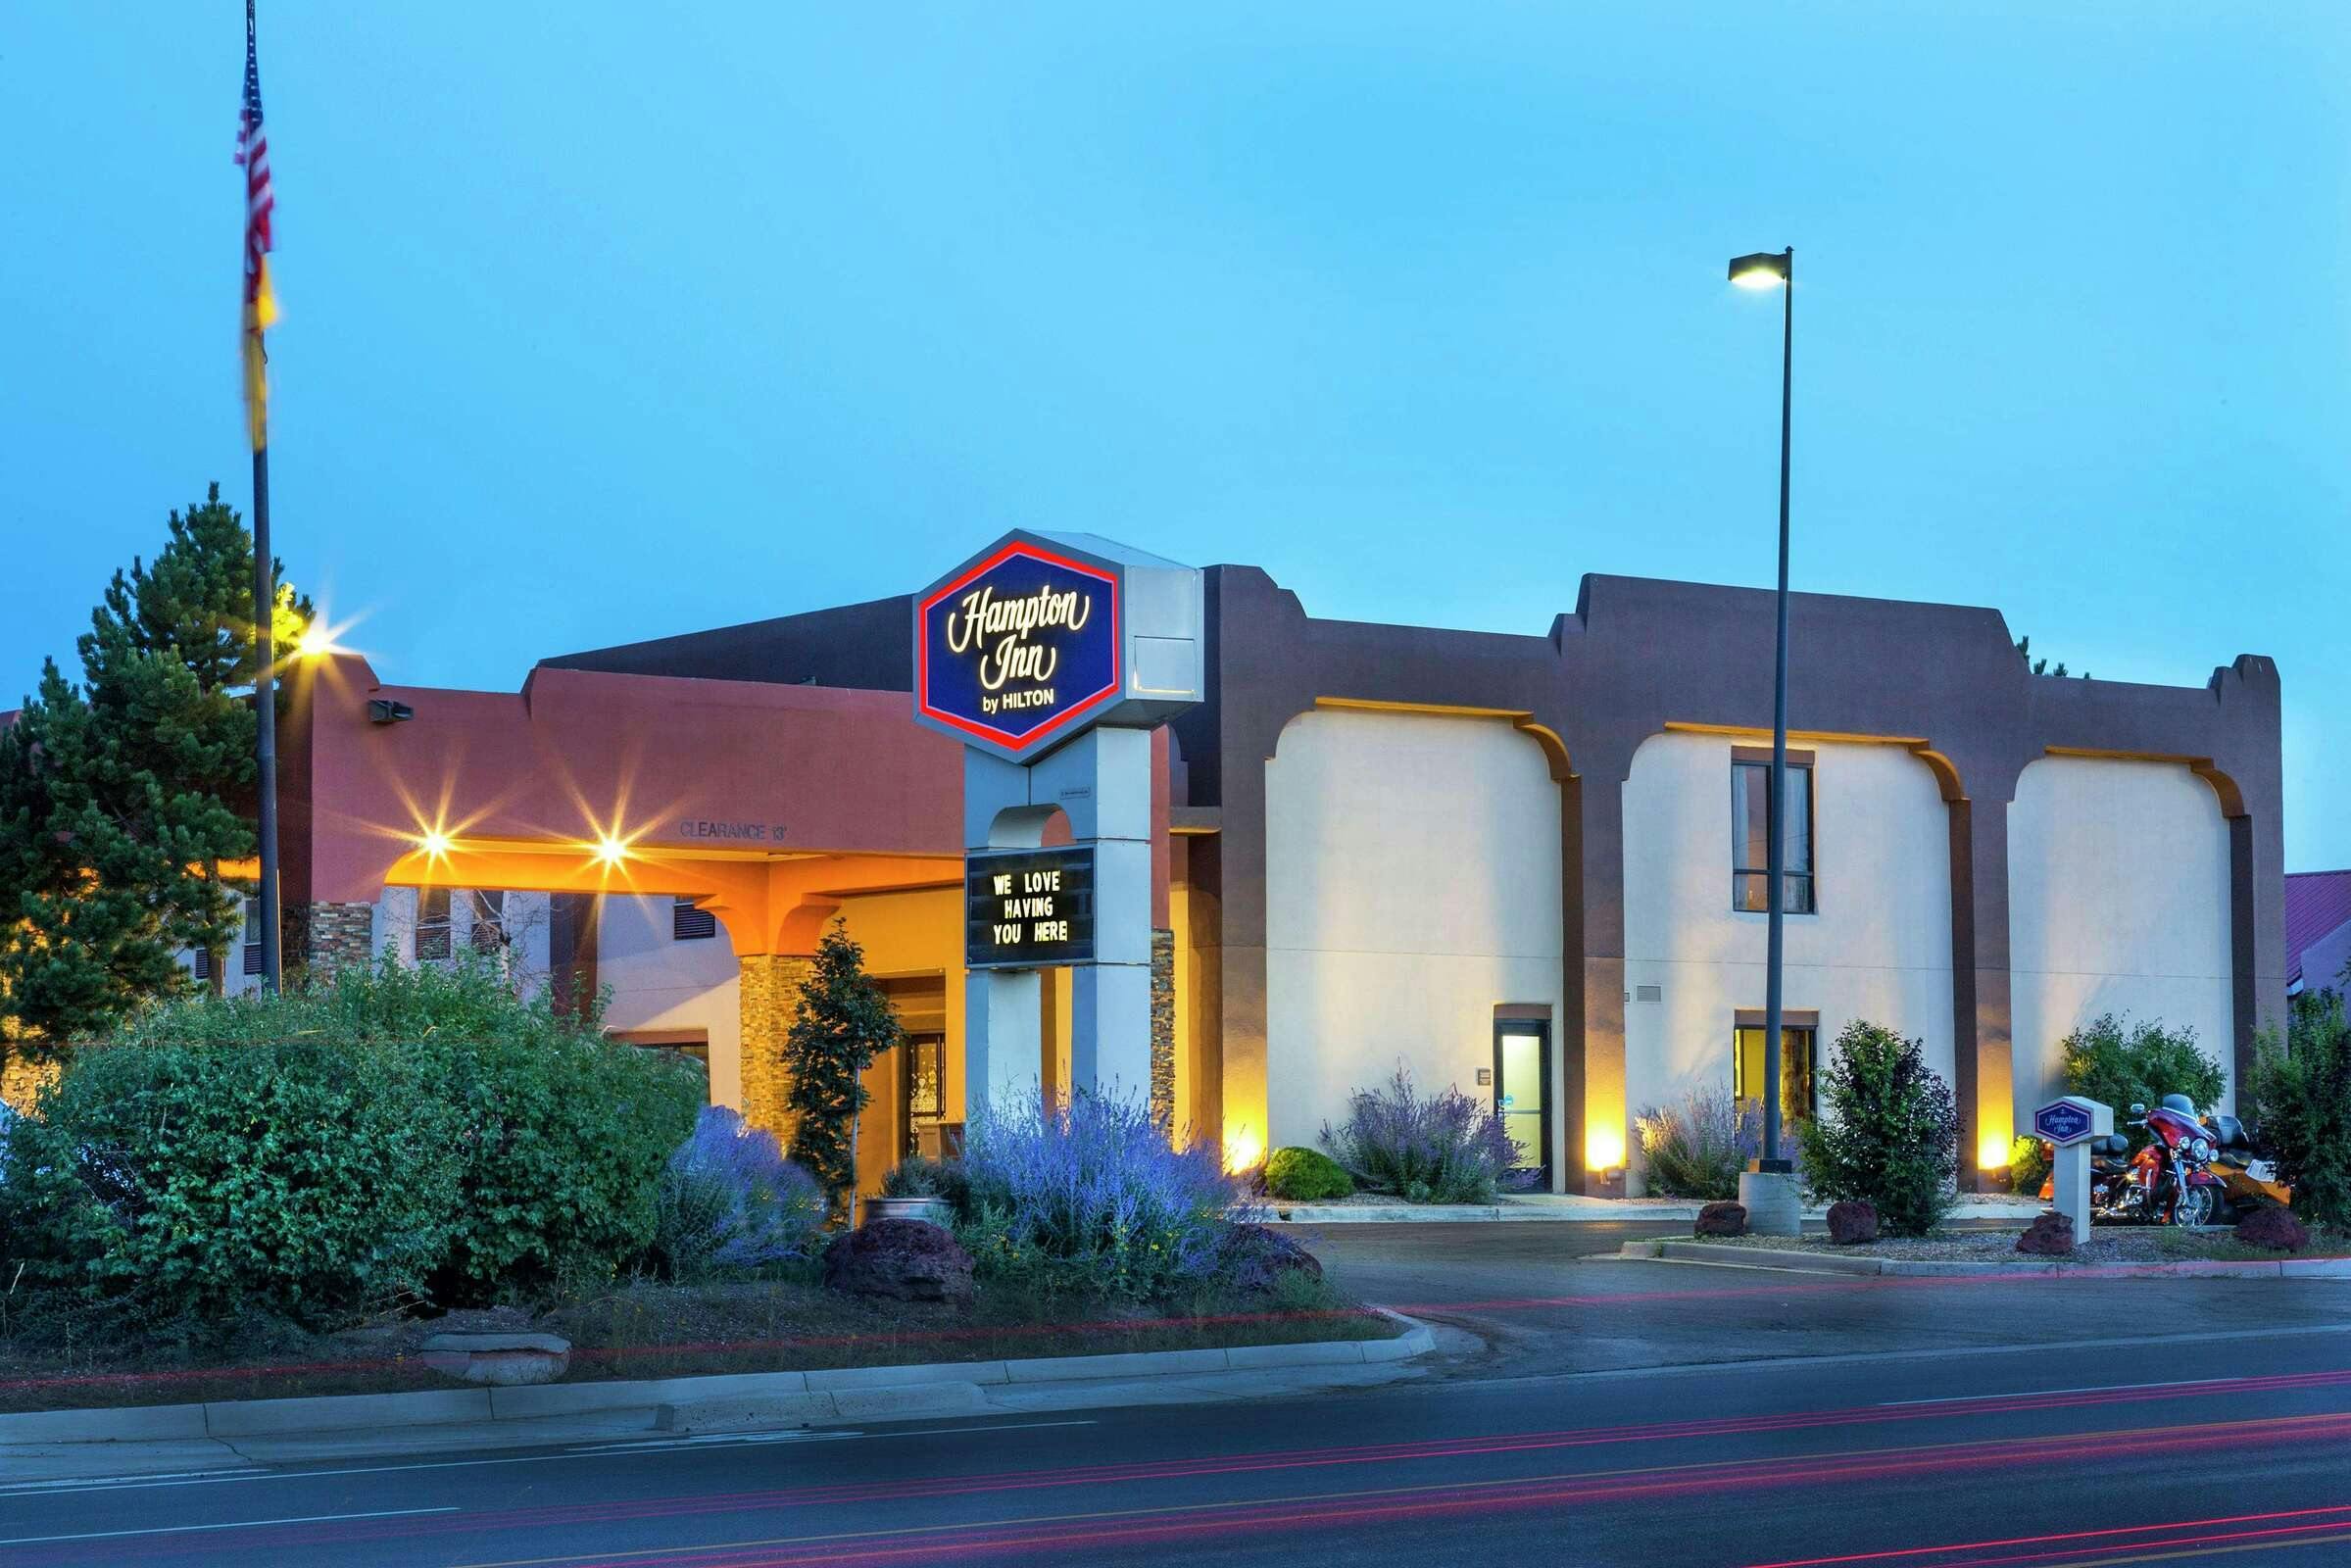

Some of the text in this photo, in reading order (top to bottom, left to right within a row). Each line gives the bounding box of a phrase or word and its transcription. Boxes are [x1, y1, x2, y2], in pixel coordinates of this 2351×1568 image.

[948, 585, 1090, 653] Hampton
[980, 634, 1056, 690] Inn
[983, 688, 1053, 714] by HILTON
[681, 821, 764, 840] CLEARANCE
[993, 870, 1060, 896] WE LOVE
[1004, 896, 1053, 919] HAVING
[993, 920, 1068, 945] YOU HERE
[2045, 1114, 2082, 1126] Hampton
[2054, 1124, 2072, 1134] Inn
